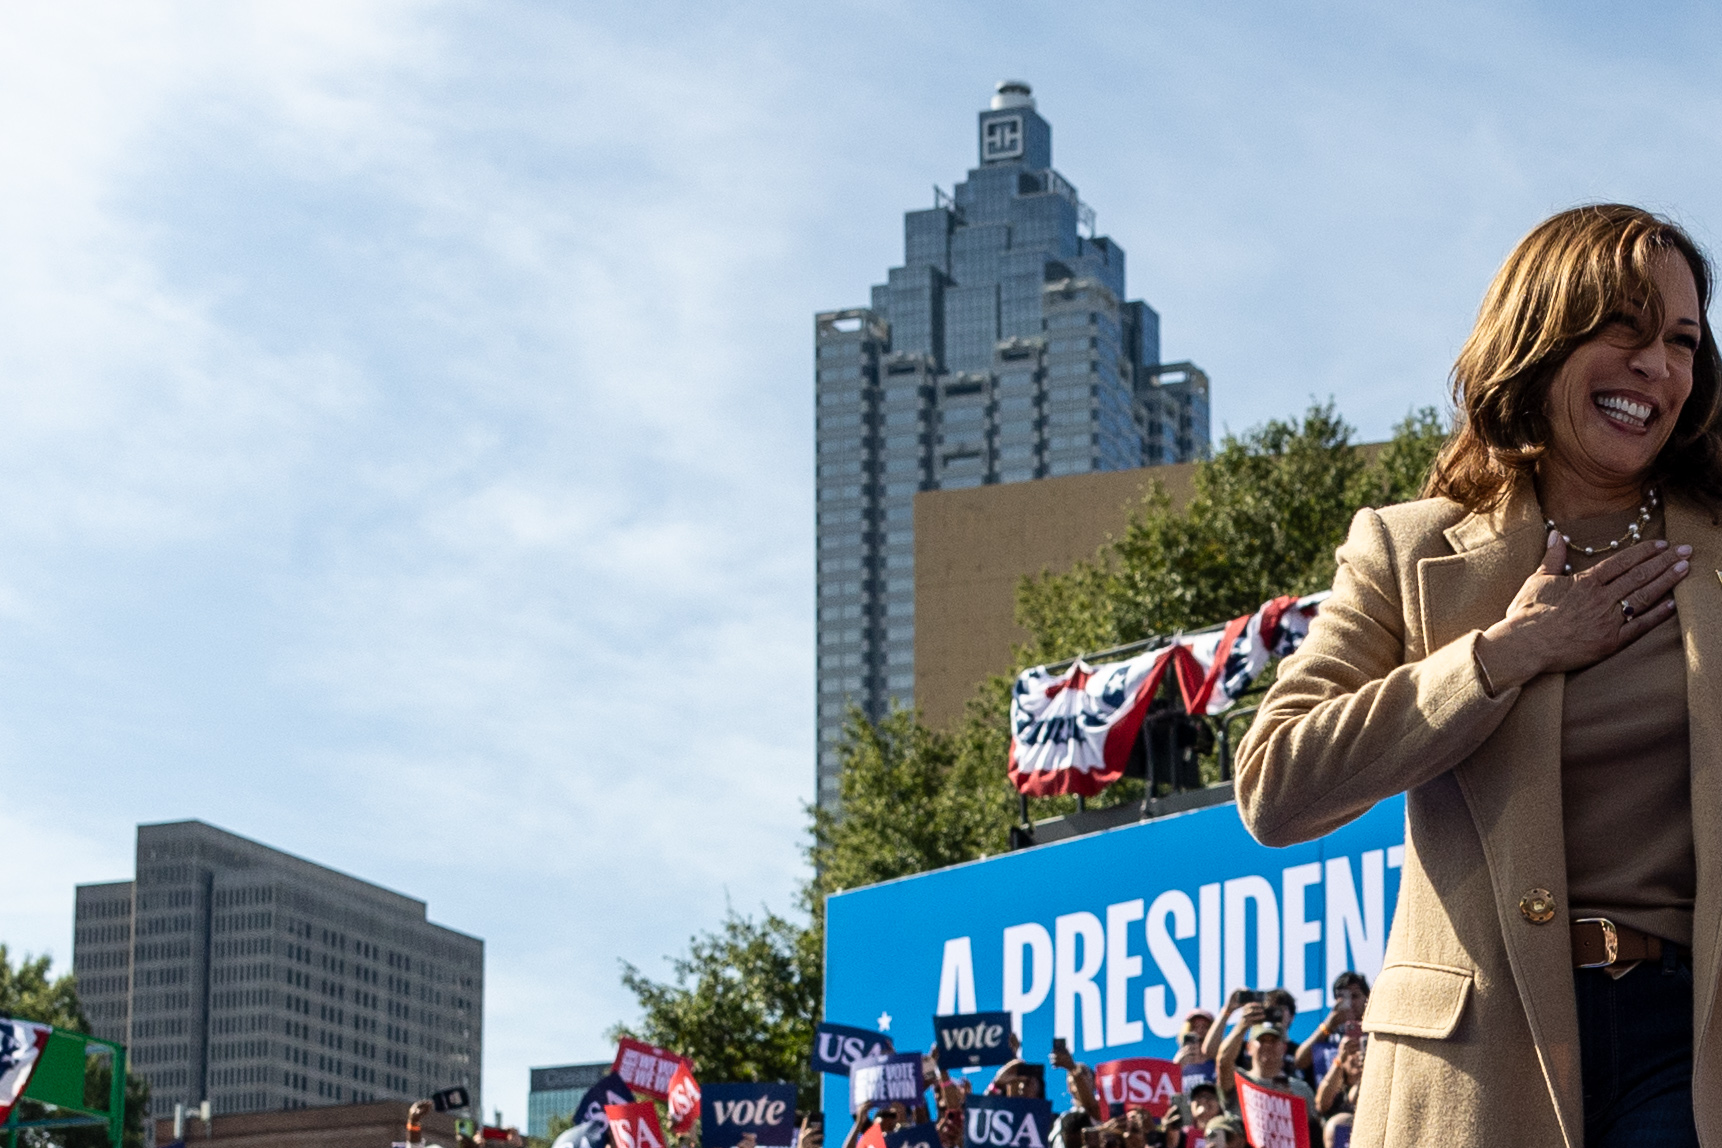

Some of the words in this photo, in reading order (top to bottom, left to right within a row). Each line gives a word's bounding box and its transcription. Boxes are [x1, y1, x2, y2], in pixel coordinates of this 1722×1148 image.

[937, 936, 978, 1015] A
[941, 1021, 1003, 1051] vote
[1101, 1069, 1176, 1105] USA
[713, 1095, 787, 1126] vote
[967, 1107, 1045, 1148] USA
